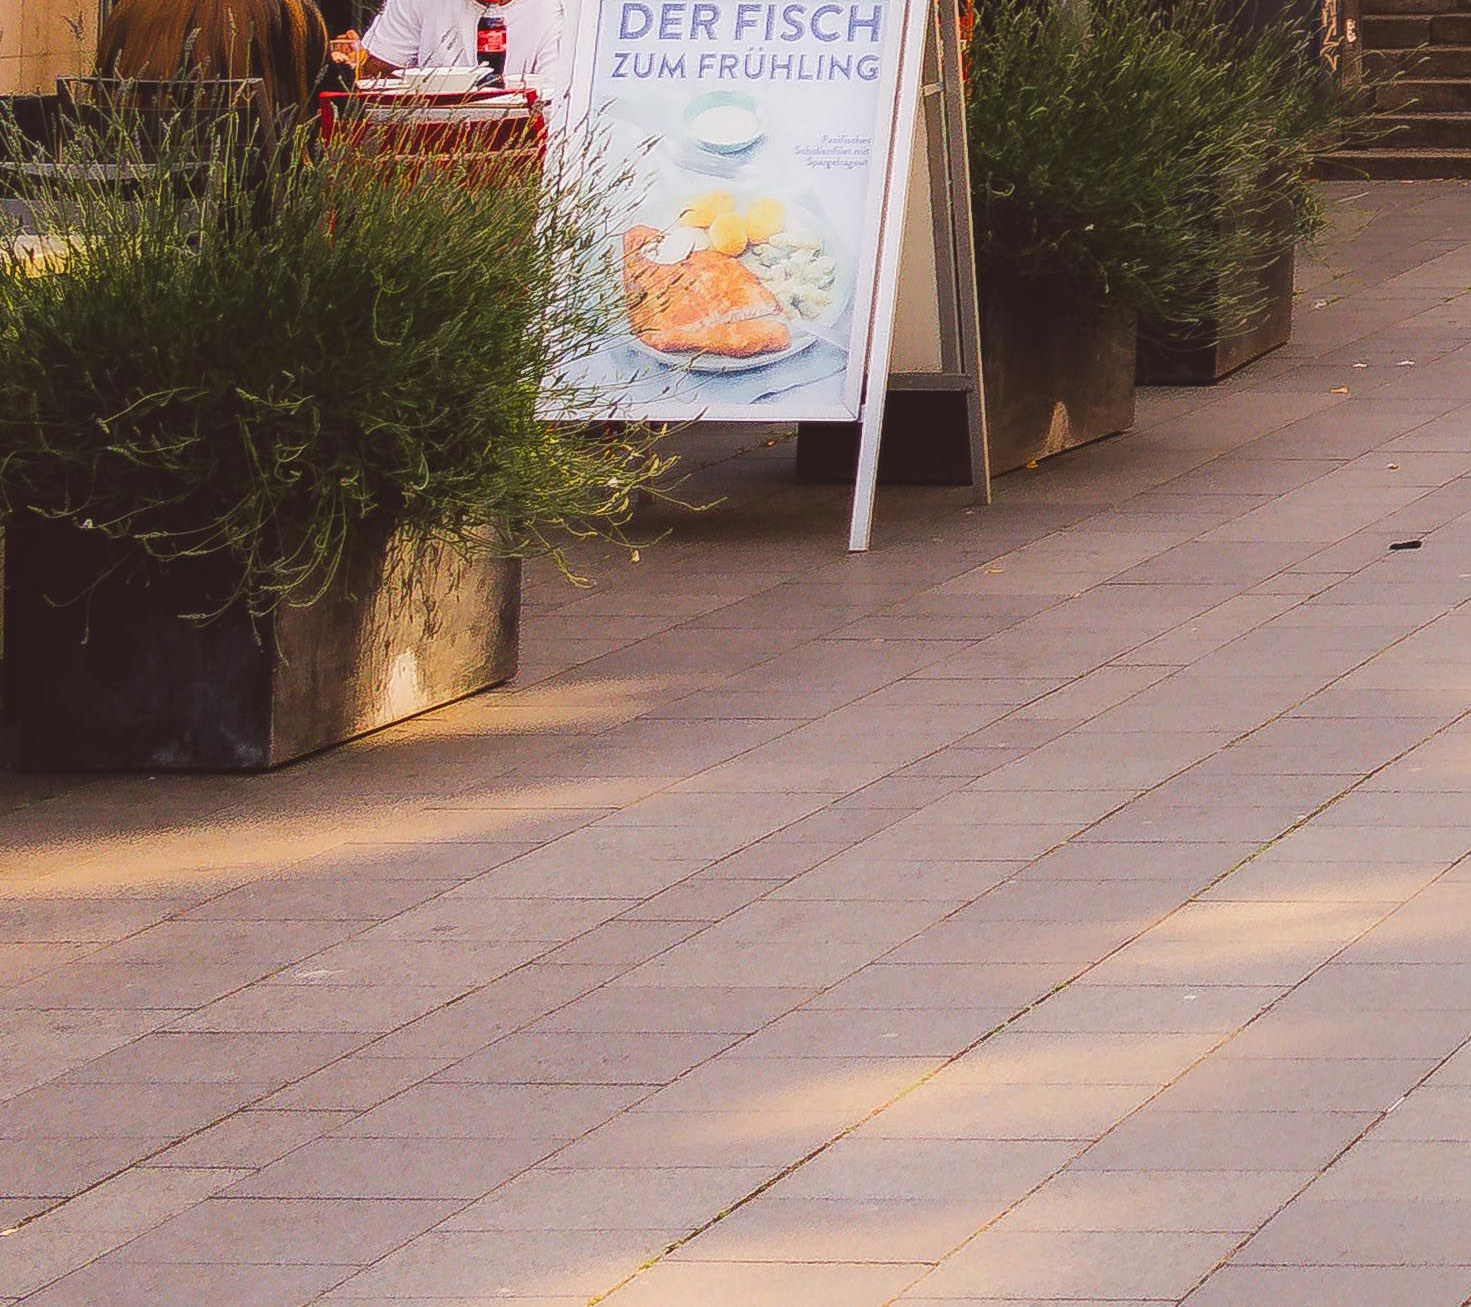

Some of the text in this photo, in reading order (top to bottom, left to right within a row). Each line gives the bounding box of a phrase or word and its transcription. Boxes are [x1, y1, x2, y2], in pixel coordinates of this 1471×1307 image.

[619, 2, 883, 43] DER FISCH
[611, 46, 881, 81] ZUM FRÜHLING
